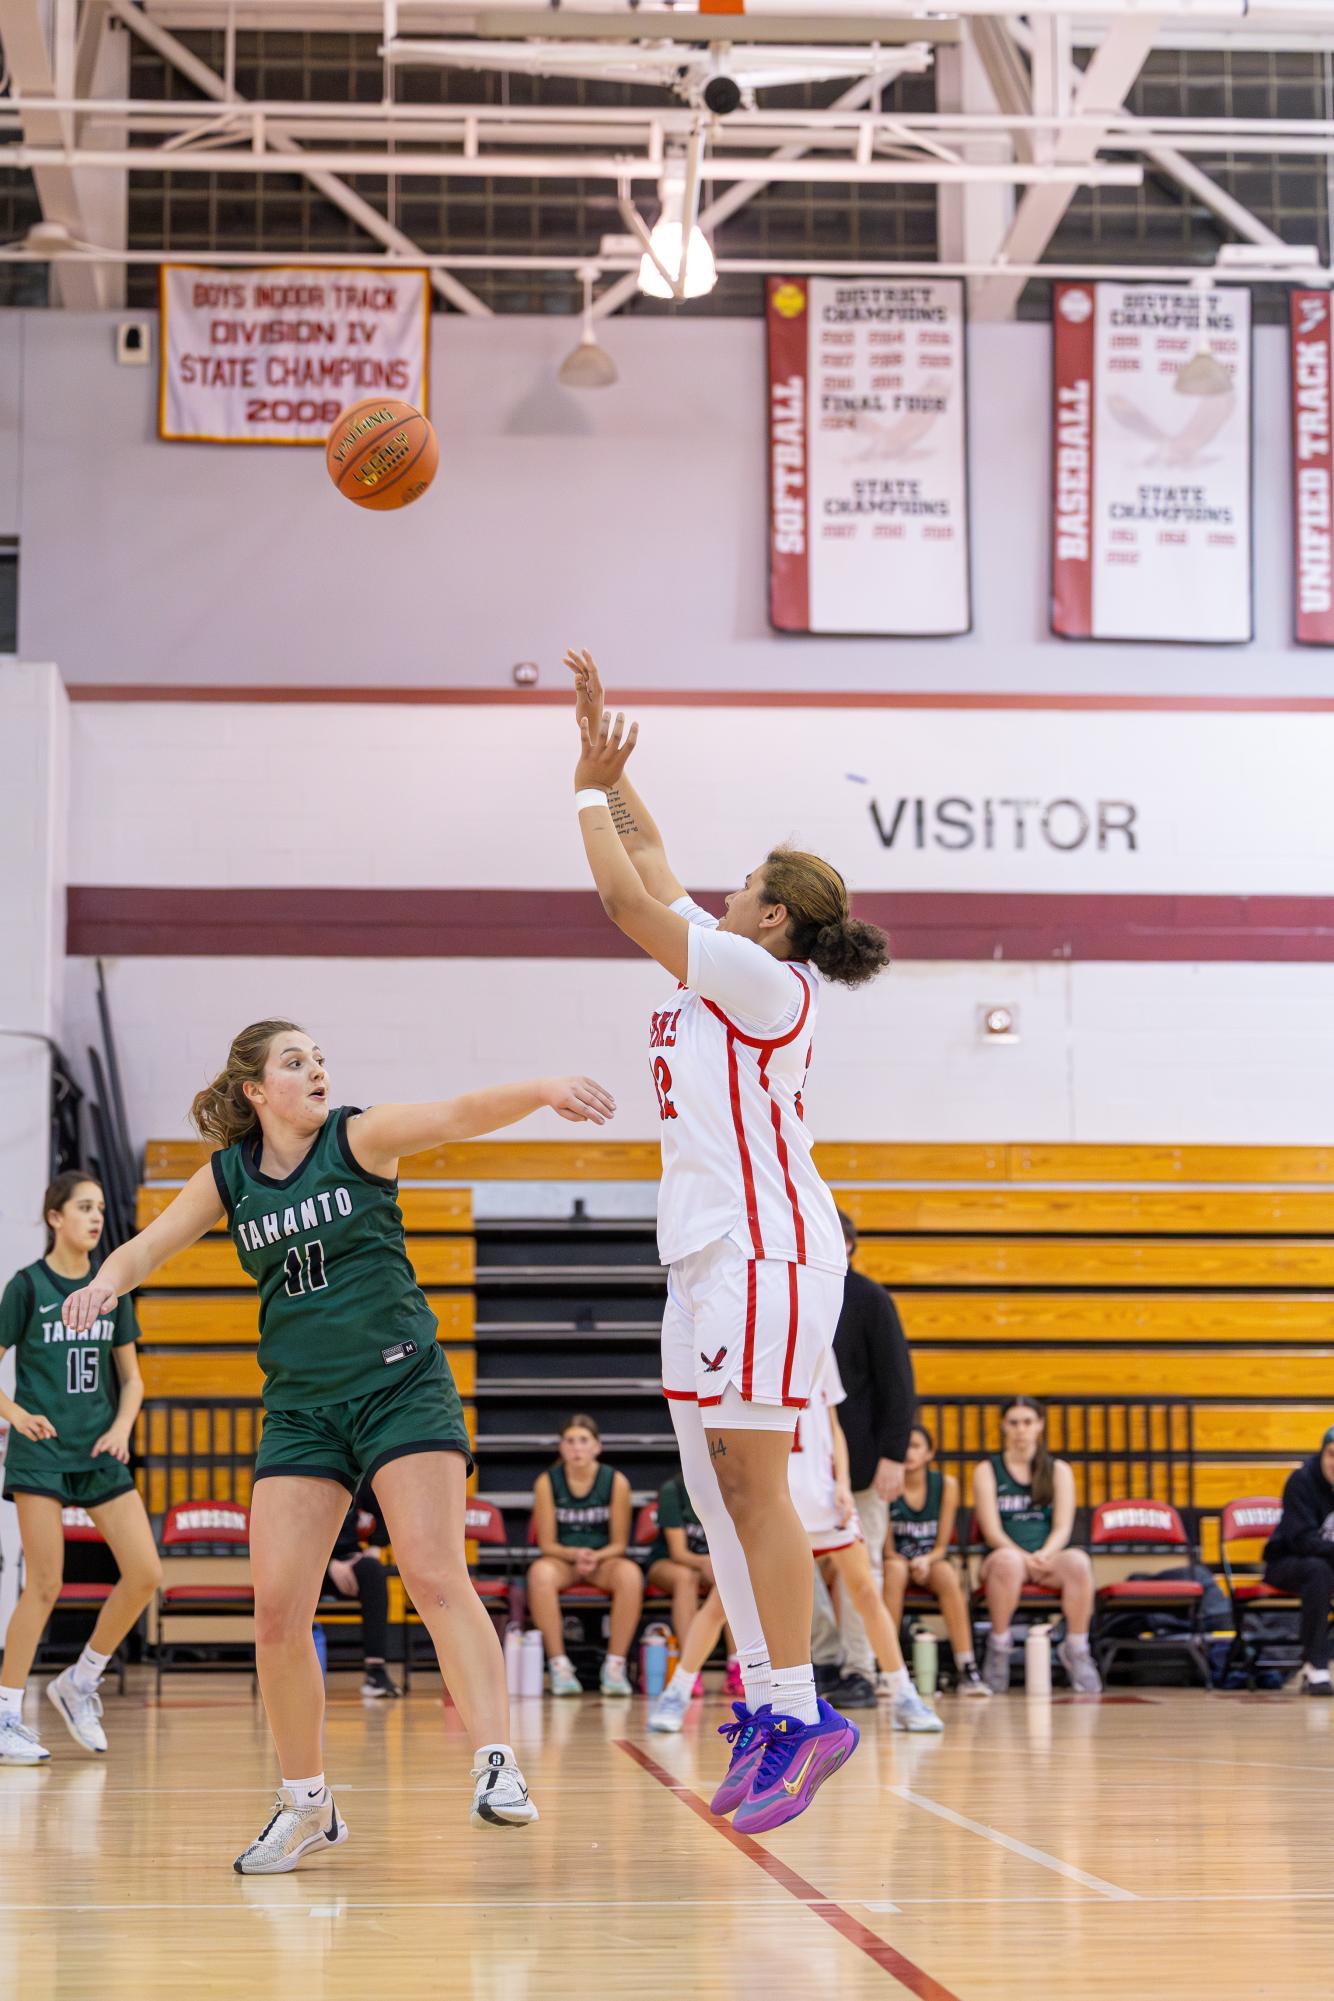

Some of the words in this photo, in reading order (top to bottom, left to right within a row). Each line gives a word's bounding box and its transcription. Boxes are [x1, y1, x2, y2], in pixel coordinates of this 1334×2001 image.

[193, 283, 246, 309] BOYS
[253, 284, 325, 310] INDOOR
[334, 285, 397, 311] TRACK
[822, 306, 947, 323] CHAMPIONS
[210, 320, 335, 346] DIVISION
[347, 321, 378, 346] IV
[180, 354, 255, 388] STATE
[265, 356, 410, 391] CHAMPIONS
[246, 399, 342, 424] 2008
[822, 395, 885, 412] FINAL
[894, 395, 946, 413] FOUR
[1297, 342, 1329, 460] TRACK
[772, 375, 805, 555] SOFTBALL
[1057, 380, 1090, 561] BASEBALL
[854, 479, 920, 497] STATE
[1138, 486, 1204, 503] STATE
[823, 500, 949, 517] CHAMPIONS
[1109, 503, 1232, 522] CHAMPIONS
[1300, 468, 1332, 614] UNIFIED
[868, 798, 1138, 851] VISITOR
[238, 1187, 353, 1252] TAHANTO
[284, 1239, 329, 1297] 11
[67, 1347, 99, 1394] 15
